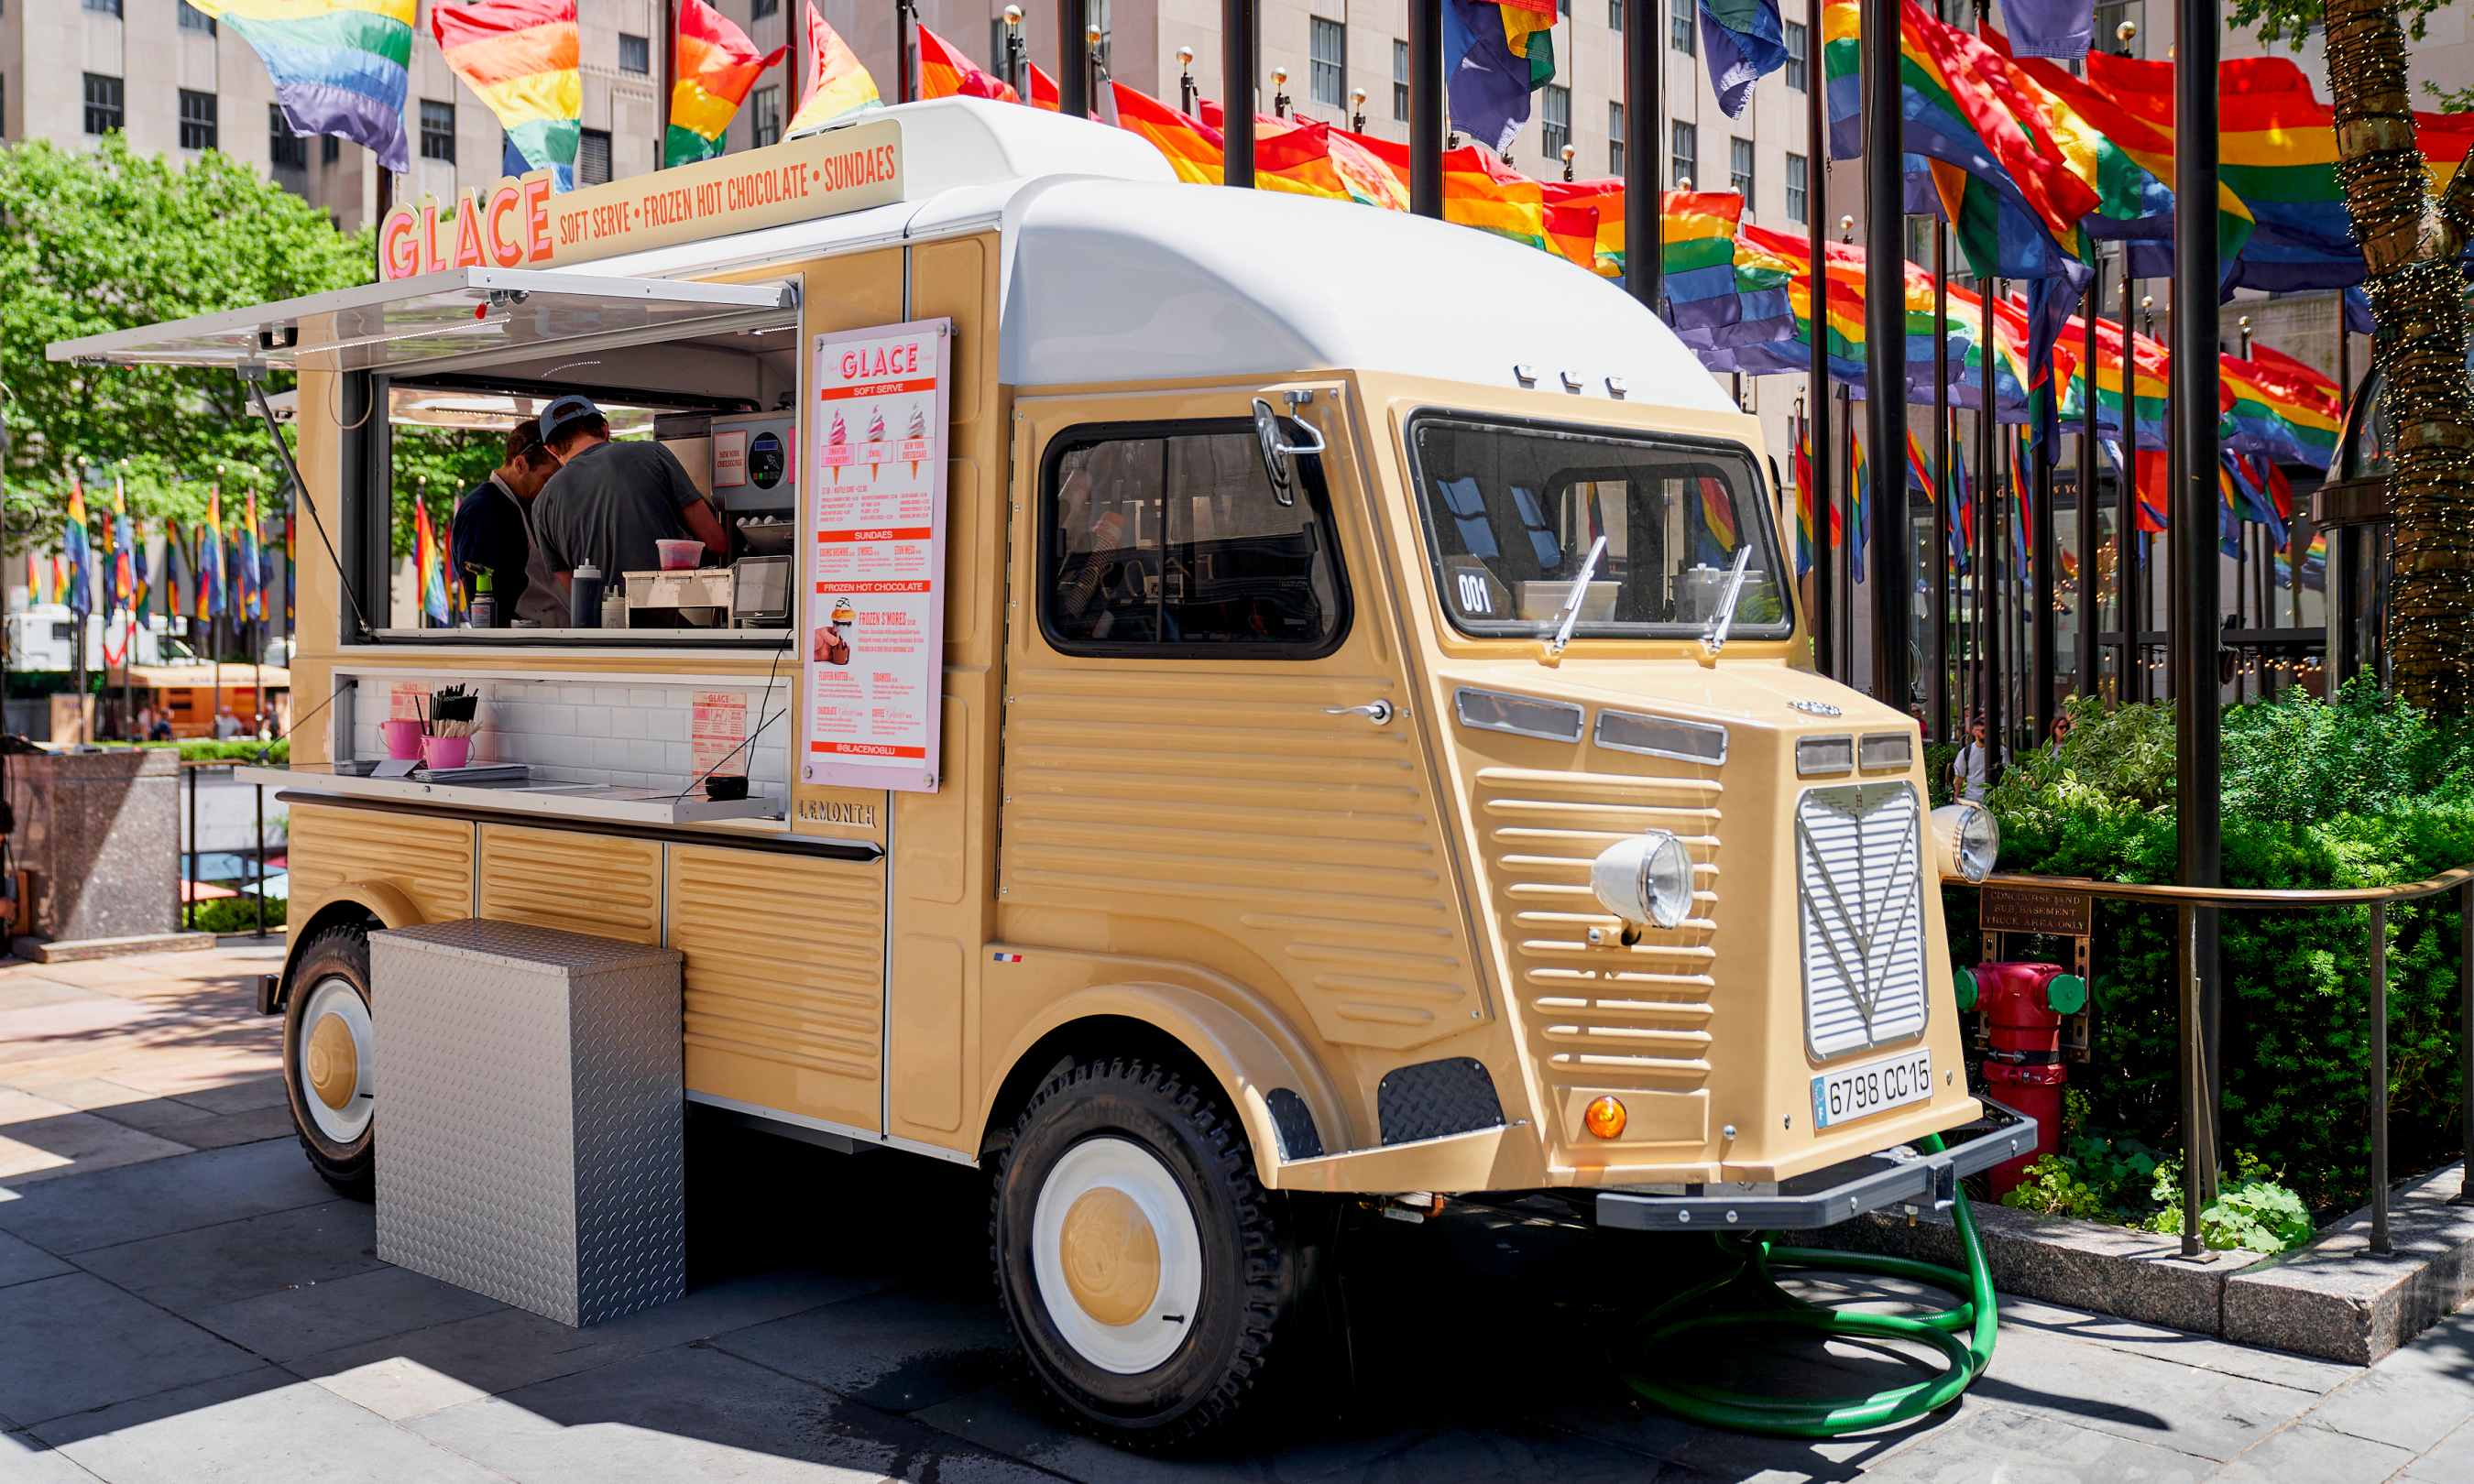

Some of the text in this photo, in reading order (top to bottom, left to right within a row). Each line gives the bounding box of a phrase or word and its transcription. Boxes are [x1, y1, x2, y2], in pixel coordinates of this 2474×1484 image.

[559, 144, 896, 246] SOFT SERVE FROZEN HOT CHOCOLATE SUNDAES
[383, 179, 554, 280] GLACE
[840, 344, 918, 380] GLACE
[853, 383, 903, 396] SOFT SERVE
[904, 441, 925, 451] NEW YORK
[719, 450, 740, 459] NEW YORK
[869, 449, 881, 458] SWIRL
[903, 450, 927, 460] CHEESECAKE
[717, 459, 742, 468] CHEESECAKE
[826, 455, 850, 465] STRAWBERRY
[834, 486, 846, 494] WAFFLE
[854, 530, 893, 540] SUNDAES
[905, 545, 915, 554] MESS
[824, 583, 924, 593] FROZEN HOT CHOCOLATE
[1458, 573, 1493, 614] 001
[859, 612, 880, 626] FROZEN
[881, 612, 906, 626] S'MORES
[708, 694, 730, 704] GLACE
[836, 743, 896, 756] @GLACENOGLU
[1990, 891, 2081, 905] CONCOURSE AND
[1995, 904, 2077, 917] SUB BASEMENT
[1985, 916, 2085, 931] TRUCK AREA ONLY
[1830, 1073, 1879, 1115] 6798
